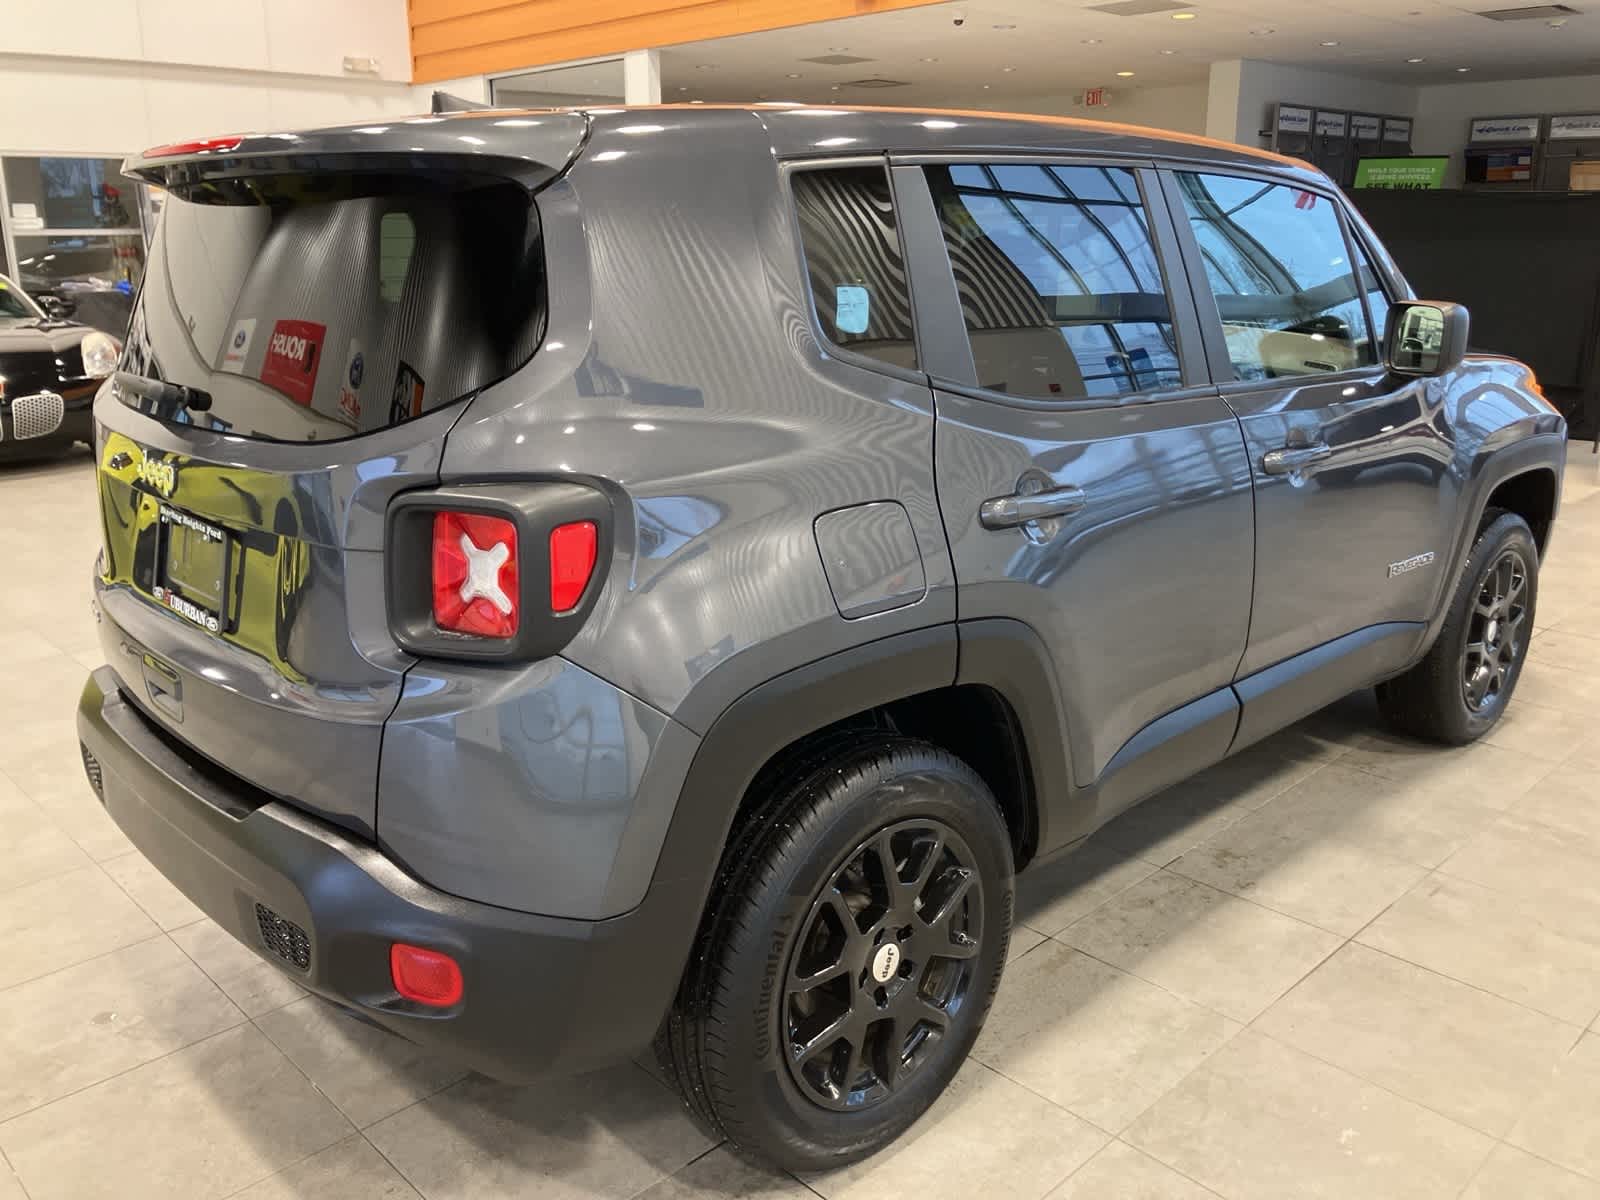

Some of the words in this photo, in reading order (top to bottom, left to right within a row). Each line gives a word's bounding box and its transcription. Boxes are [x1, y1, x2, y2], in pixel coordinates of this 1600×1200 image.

[1087, 89, 1102, 105] EXIT
[138, 449, 175, 496] Jeep
[206, 525, 222, 540] Ford
[163, 588, 207, 626] SUBURBAN
[882, 947, 895, 978] Jeep
